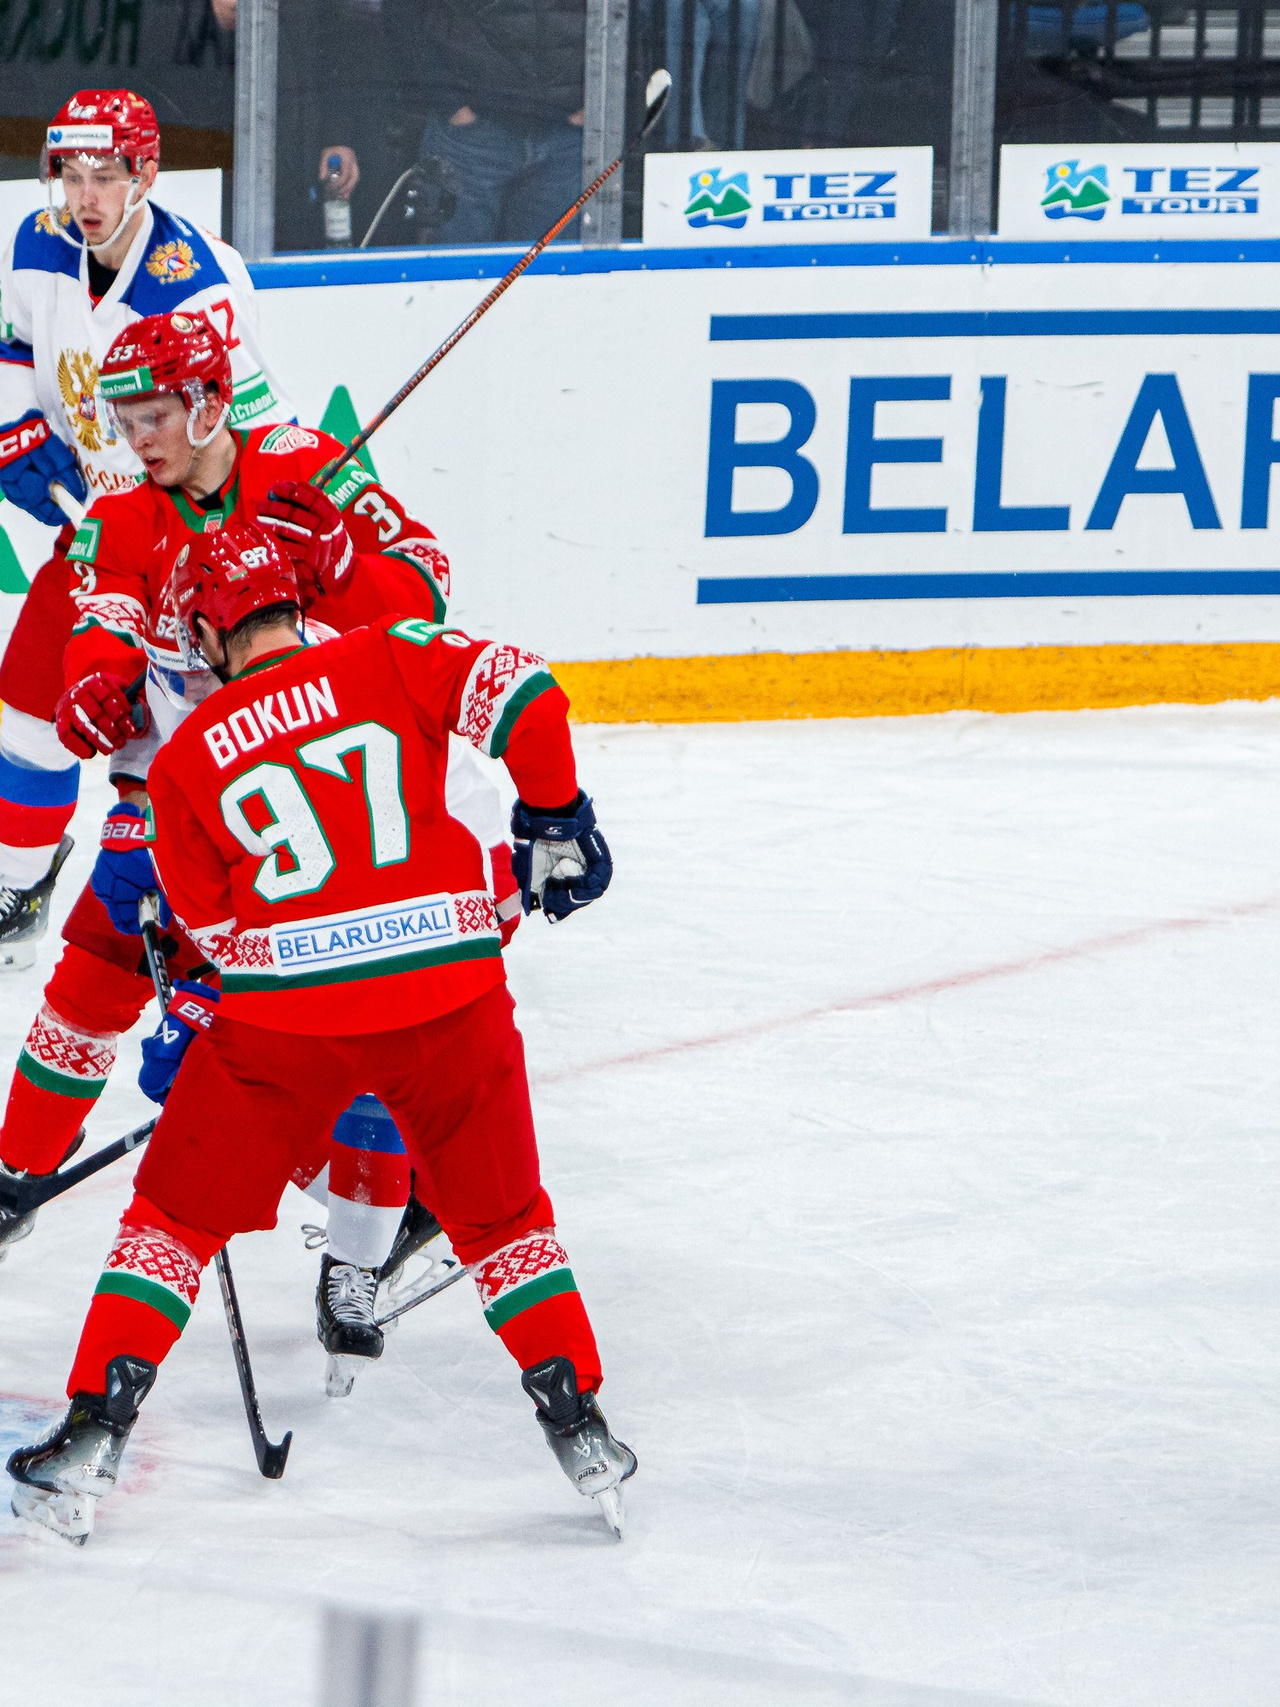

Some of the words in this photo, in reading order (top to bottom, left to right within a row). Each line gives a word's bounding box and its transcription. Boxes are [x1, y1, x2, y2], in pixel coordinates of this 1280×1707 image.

[764, 171, 897, 199] TEZ
[1123, 167, 1260, 193] TEZ
[774, 203, 884, 219] TOUR
[1134, 198, 1247, 213] TOUR
[239, 546, 269, 569] 97
[155, 613, 179, 640] 52
[203, 676, 339, 769] BOKUN
[219, 720, 410, 904] 97
[102, 821, 146, 841] BAU
[277, 907, 451, 960] BELARUSKALI
